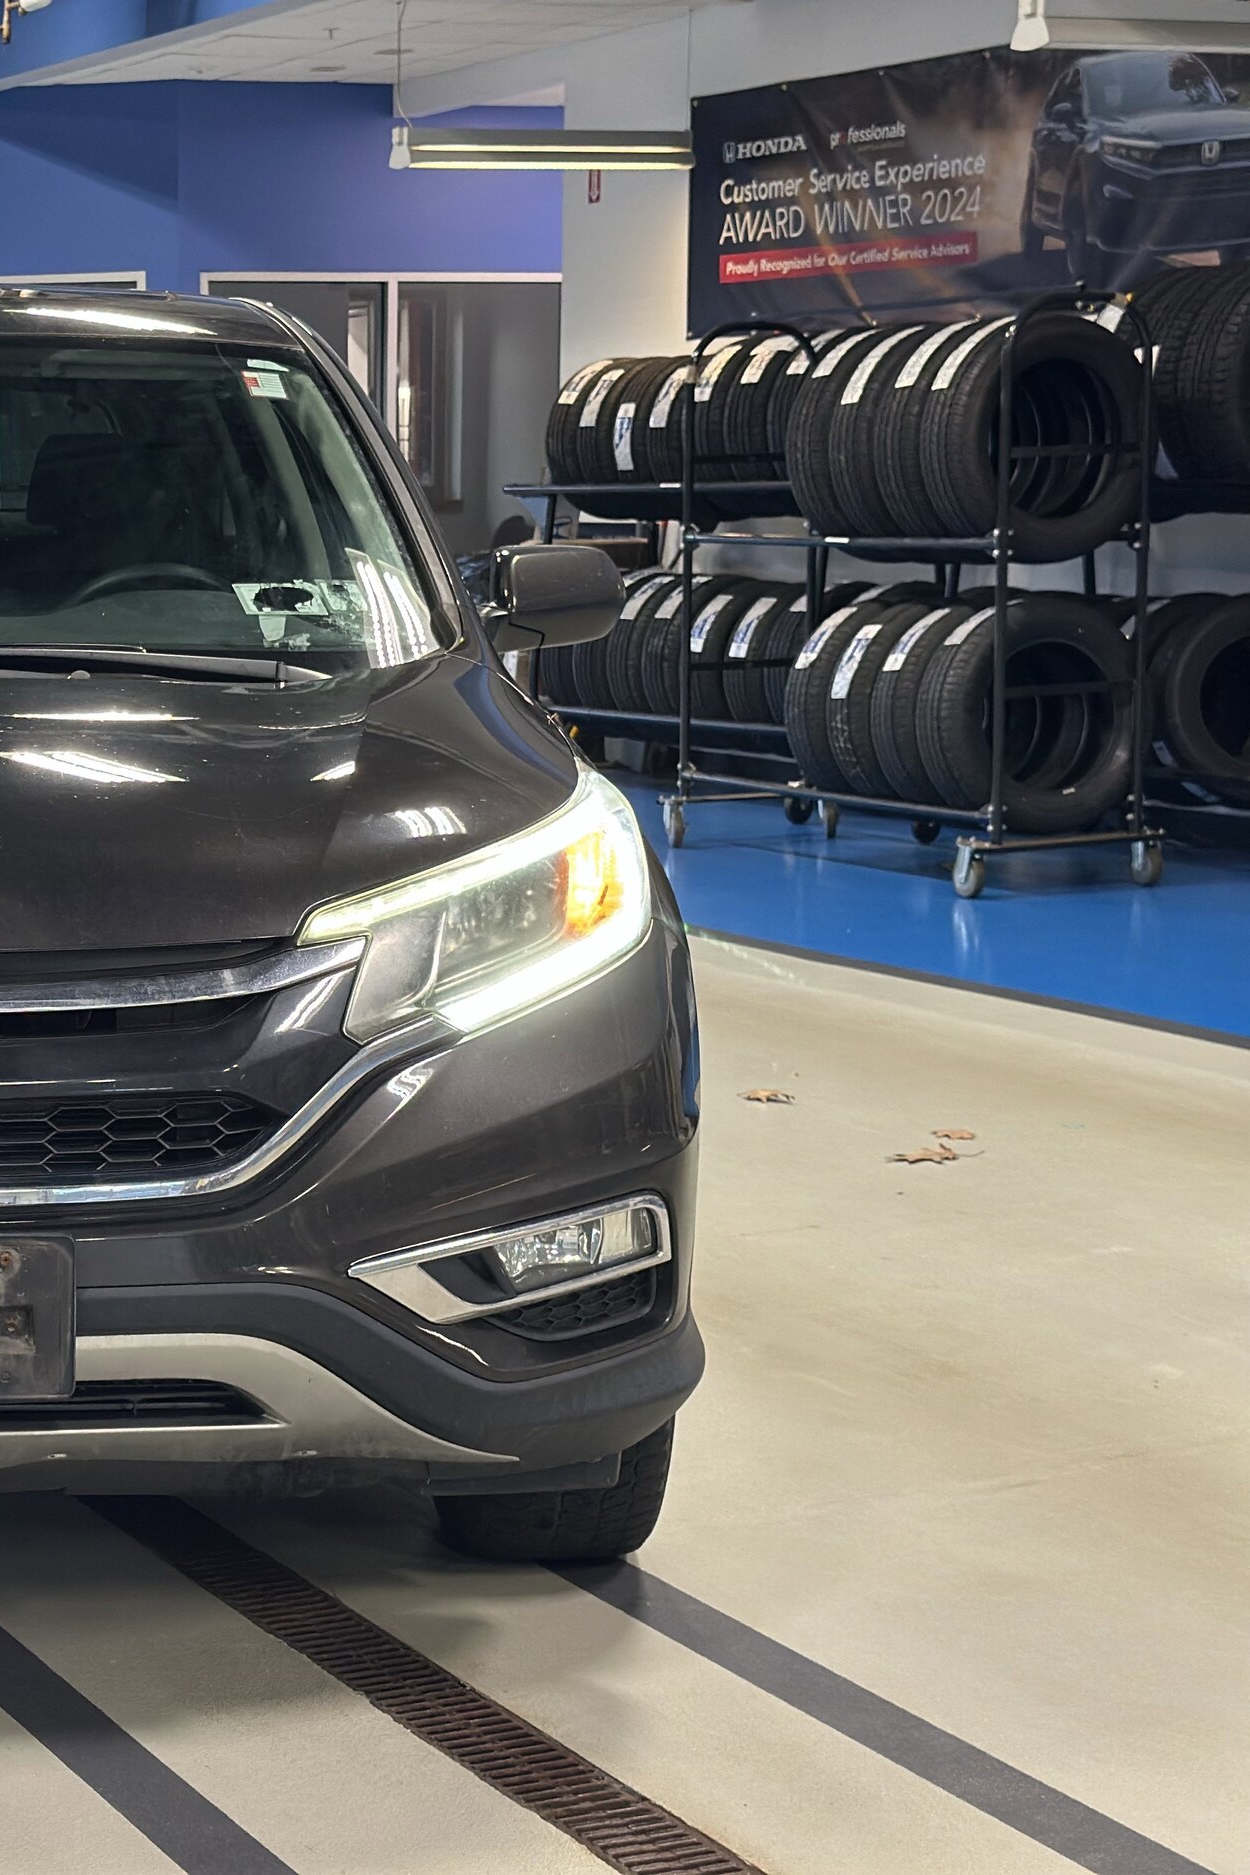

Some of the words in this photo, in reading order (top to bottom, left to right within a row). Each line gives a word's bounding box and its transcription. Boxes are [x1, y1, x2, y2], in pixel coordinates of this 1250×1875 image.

[736, 134, 807, 160] HONDA
[720, 178, 804, 206] Customer
[808, 165, 870, 194] Service
[874, 154, 986, 190] Experience
[719, 206, 805, 246] AWARD
[814, 194, 914, 235] WINNER
[919, 185, 981, 225] 2024
[726, 261, 759, 277] Proudly
[759, 253, 812, 275] Recognized
[813, 254, 827, 268] for
[828, 253, 848, 266] Our
[849, 247, 889, 266] Certified
[892, 246, 929, 260] Service
[930, 242, 971, 257] Advisors
